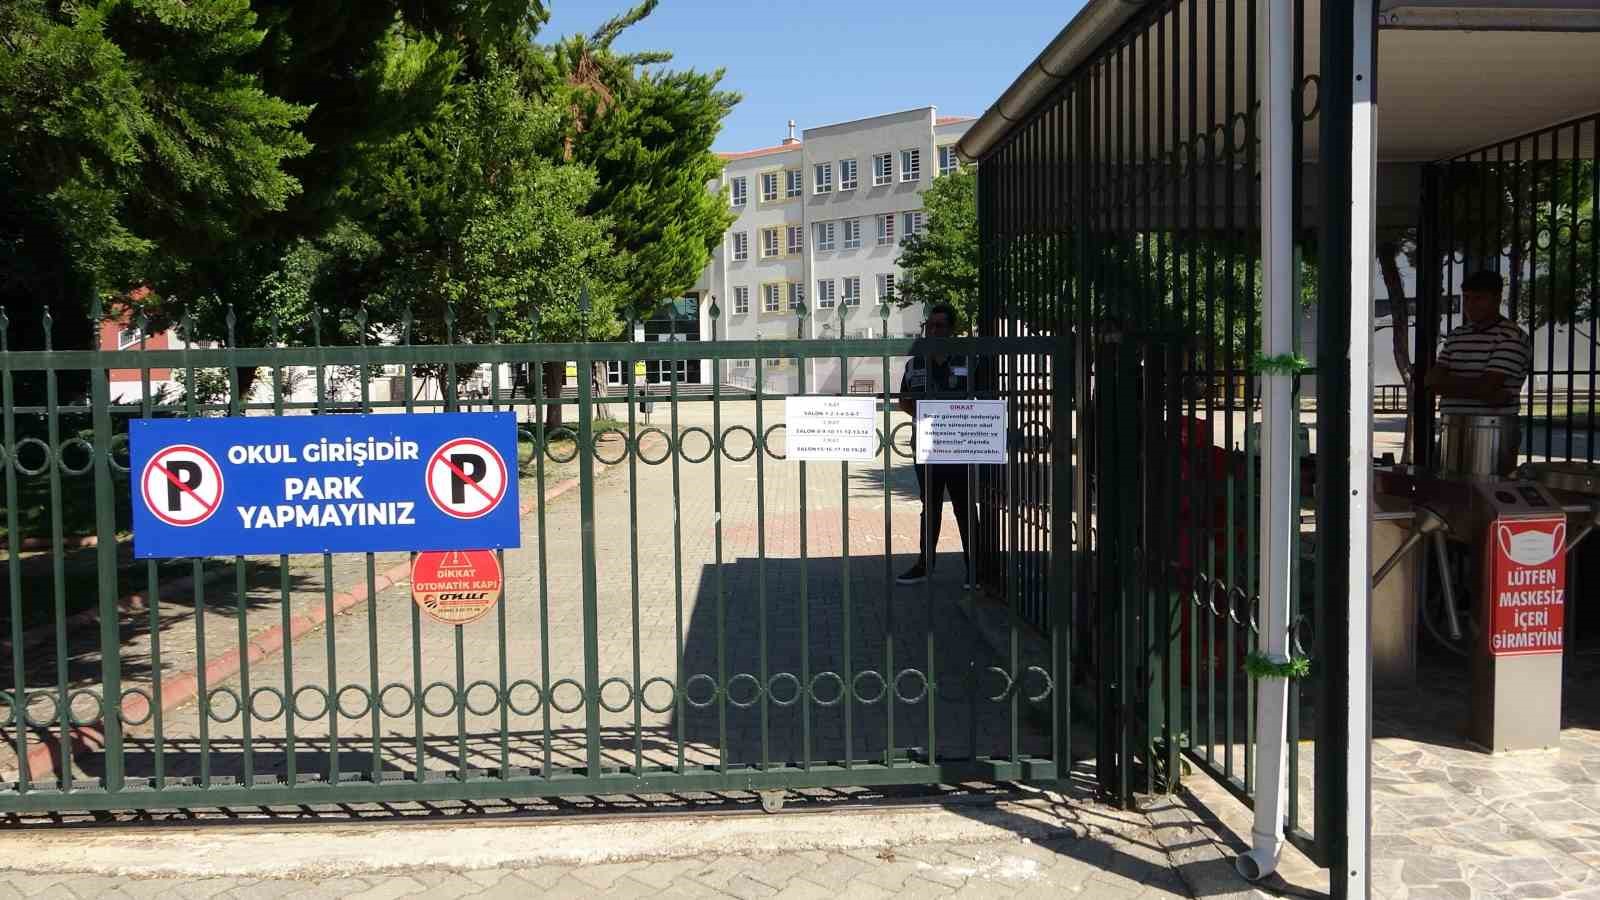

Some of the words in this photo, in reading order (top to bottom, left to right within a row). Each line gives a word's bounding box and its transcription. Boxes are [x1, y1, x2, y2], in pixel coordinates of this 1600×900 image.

[228, 444, 297, 465] OKUL
[303, 436, 419, 467] GİRİŞİDİR
[285, 475, 364, 501] PARK
[237, 502, 415, 528] YAPMAYINIZ
[436, 569, 476, 578] DİKKAT
[1507, 567, 1556, 586] LÜTFEN
[416, 581, 470, 591] OTOMATİK
[473, 580, 497, 589] KAPI
[1499, 586, 1564, 607] MASKESİZ
[1514, 607, 1548, 631] İÇERİ
[1492, 627, 1563, 649] GİRMEYİNİ
